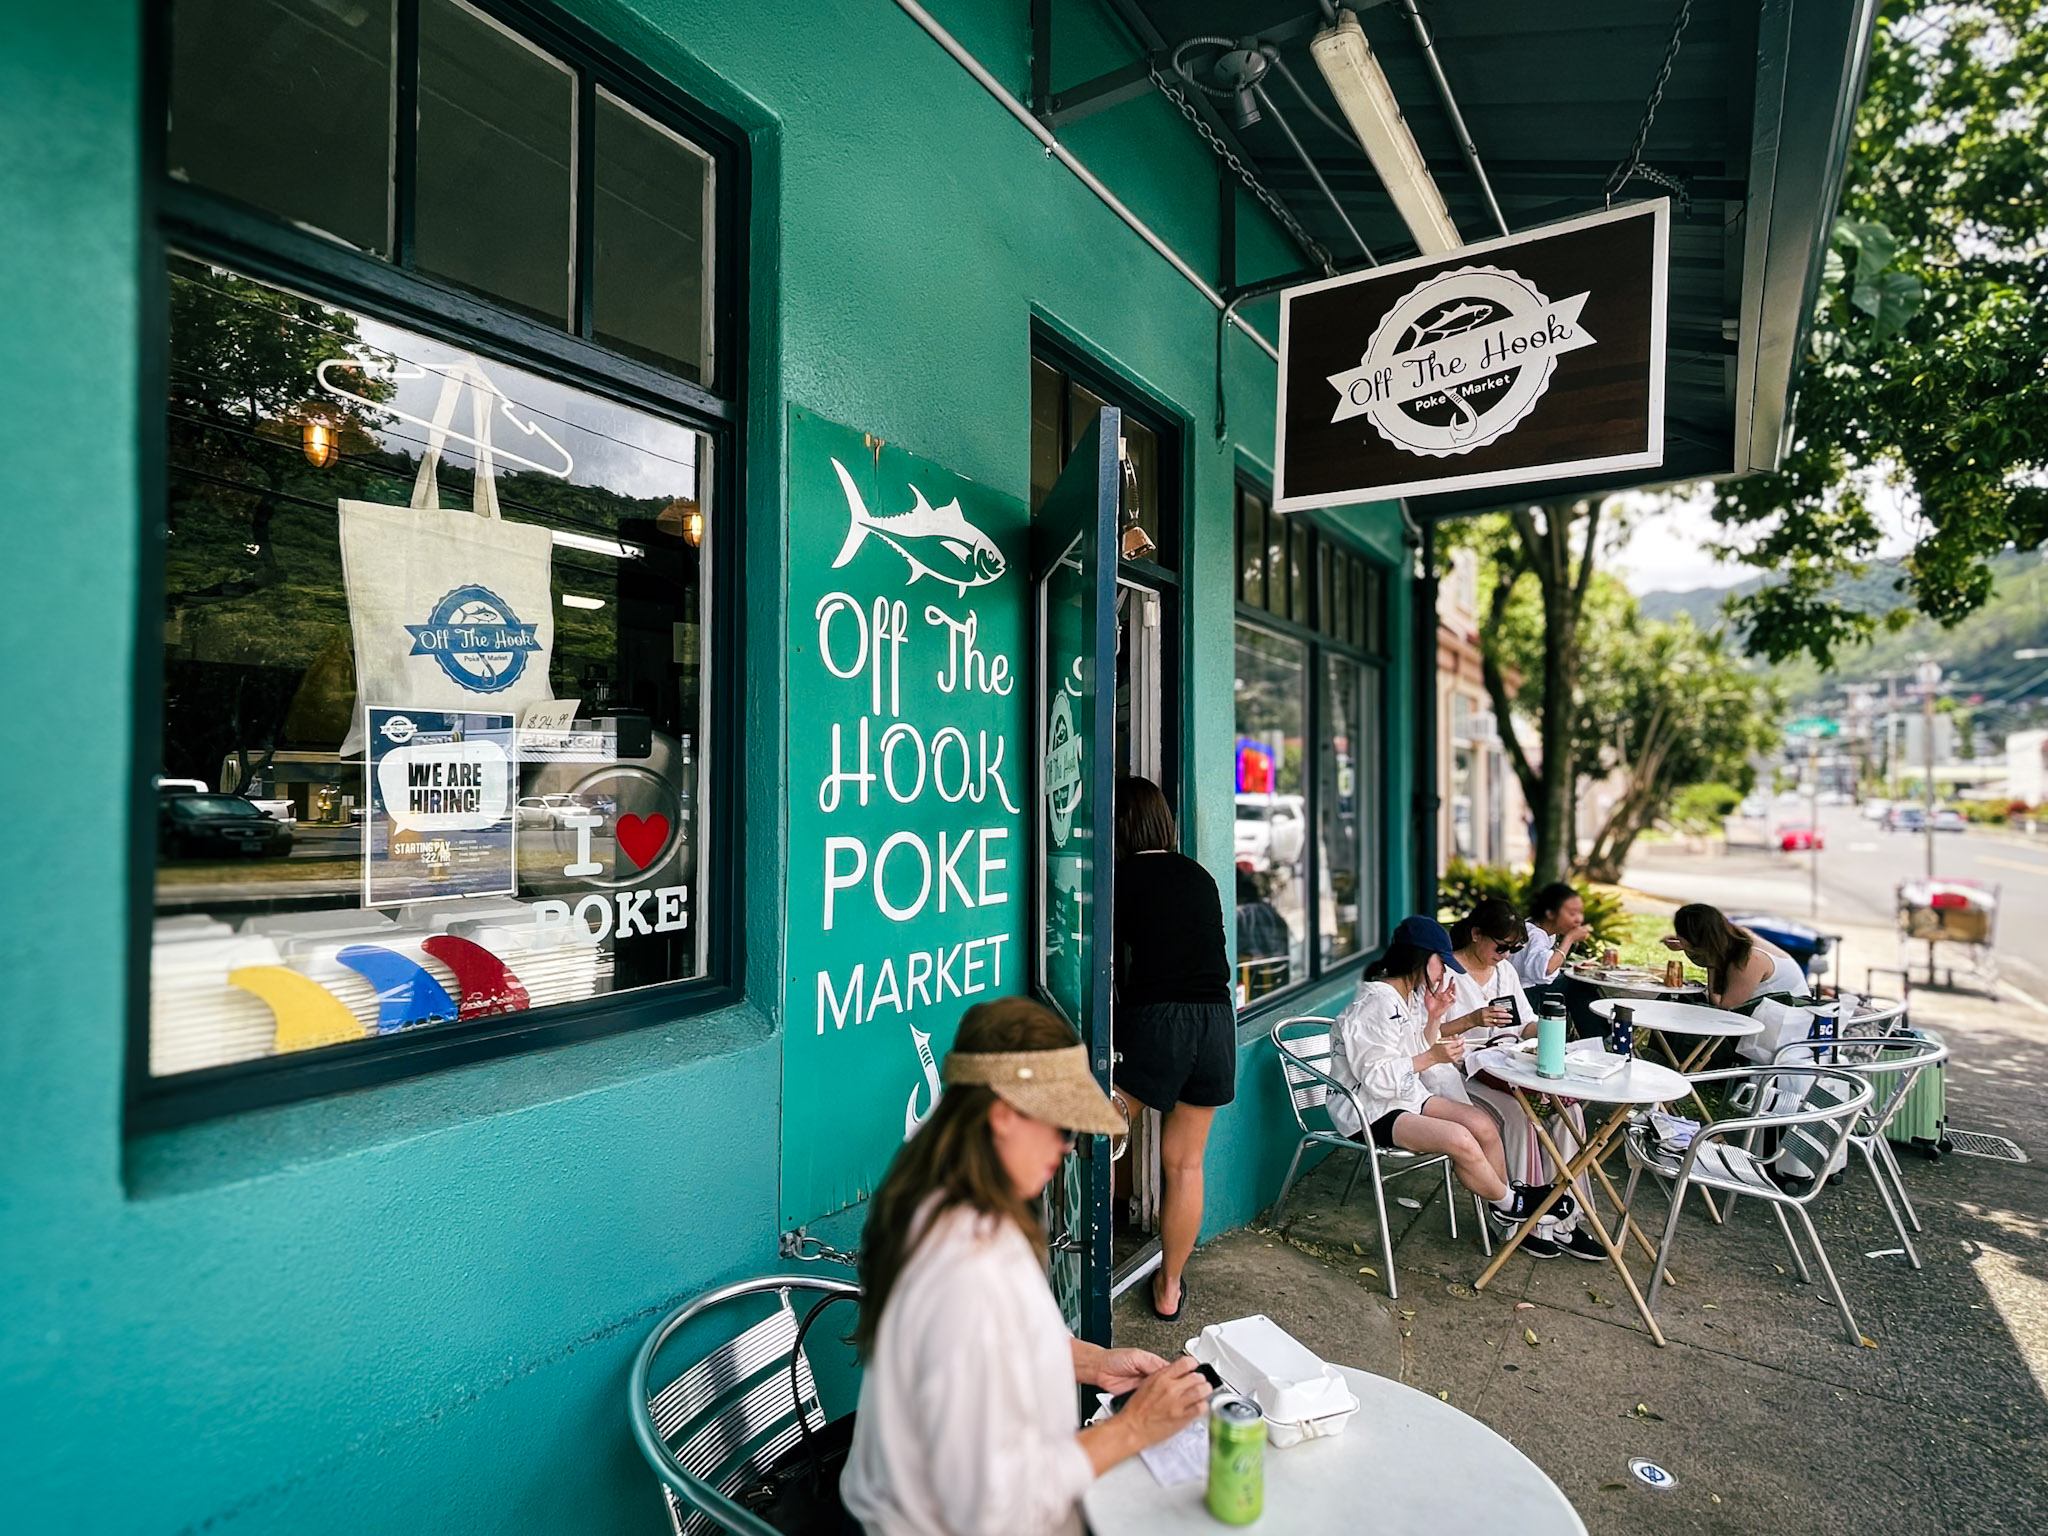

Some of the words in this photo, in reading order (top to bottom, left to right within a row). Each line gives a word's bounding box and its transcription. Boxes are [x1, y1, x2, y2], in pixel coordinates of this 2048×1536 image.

[1348, 366, 1393, 406] Off
[1402, 350, 1467, 388] The
[1480, 314, 1573, 369] Hook
[1415, 394, 1447, 412] Poke
[1461, 374, 1511, 398] Market
[419, 629, 449, 650] Off
[454, 627, 489, 649] The
[494, 628, 534, 650] Hook
[815, 591, 909, 718] Off
[924, 604, 1014, 696] The
[408, 762, 442, 787] WE
[447, 763, 482, 787] ARE
[818, 715, 1021, 815] HOOK
[409, 789, 481, 815] HIRING!
[394, 841, 433, 855] STARTING
[434, 841, 451, 852] PAY
[421, 850, 451, 864] $22/HR
[563, 815, 604, 877] I
[822, 827, 1009, 931] POKE
[531, 885, 688, 950] POKE
[817, 933, 1010, 1036] MARKET
